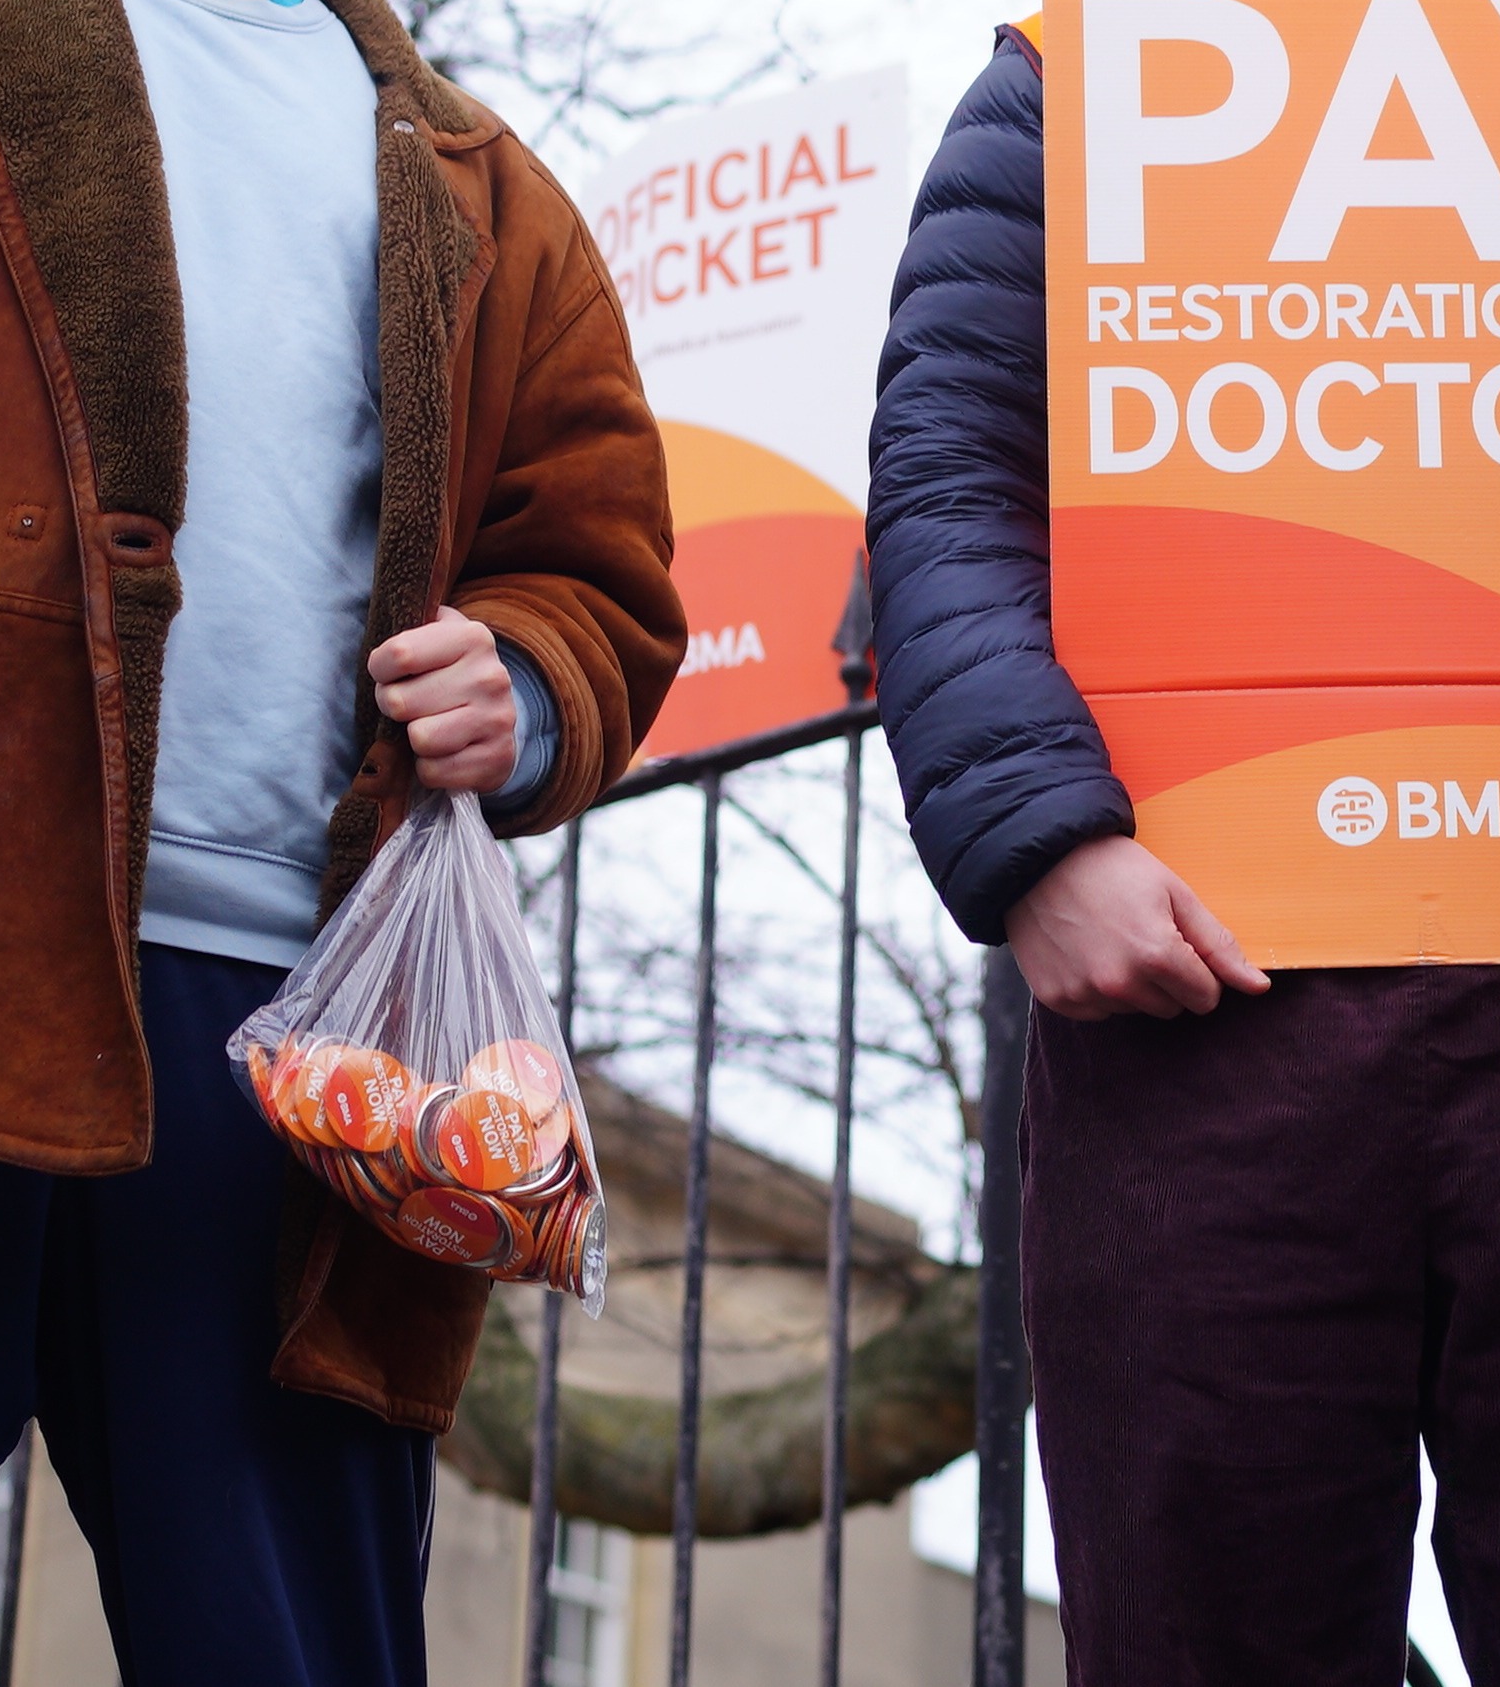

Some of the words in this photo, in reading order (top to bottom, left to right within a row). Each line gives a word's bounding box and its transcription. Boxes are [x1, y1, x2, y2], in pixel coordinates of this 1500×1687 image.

[596, 124, 876, 265] OFFICIAL
[363, 1077, 387, 1123] NOW
[478, 1116, 506, 1161] NOW
[485, 1094, 522, 1174] RESTORATION
[505, 1111, 529, 1146] PAY
[402, 1213, 473, 1261] RESTORATION
[413, 1234, 447, 1256] PAY
[424, 1215, 465, 1245] NOW
